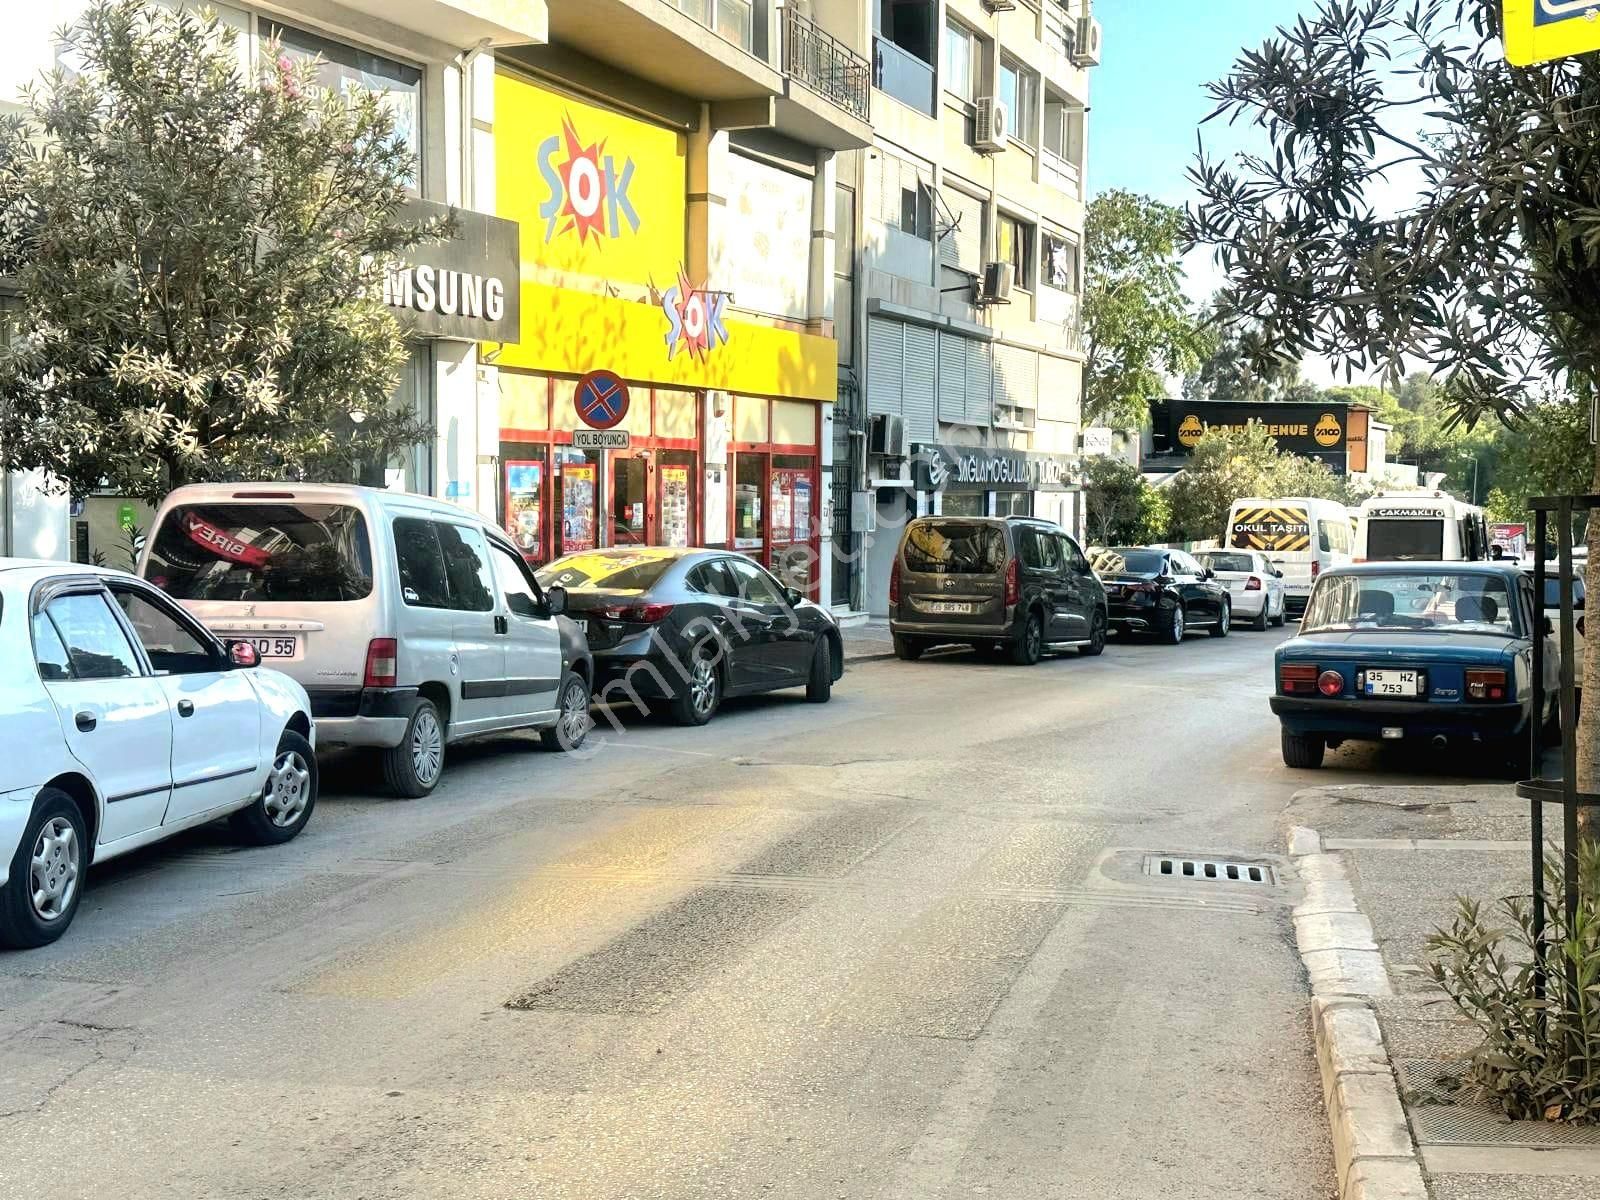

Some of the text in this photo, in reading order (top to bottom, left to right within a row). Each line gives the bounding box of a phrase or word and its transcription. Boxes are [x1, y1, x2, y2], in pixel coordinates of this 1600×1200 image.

[537, 135, 641, 245] ŞOK
[384, 263, 504, 322] MSUNG
[662, 286, 729, 362] ŞOK
[575, 433, 627, 447] YOL BOYUNCA
[1235, 524, 1267, 532] OKUL
[275, 640, 294, 655] 55
[1369, 672, 1414, 682] 35 HZ
[1382, 684, 1403, 693] 753
